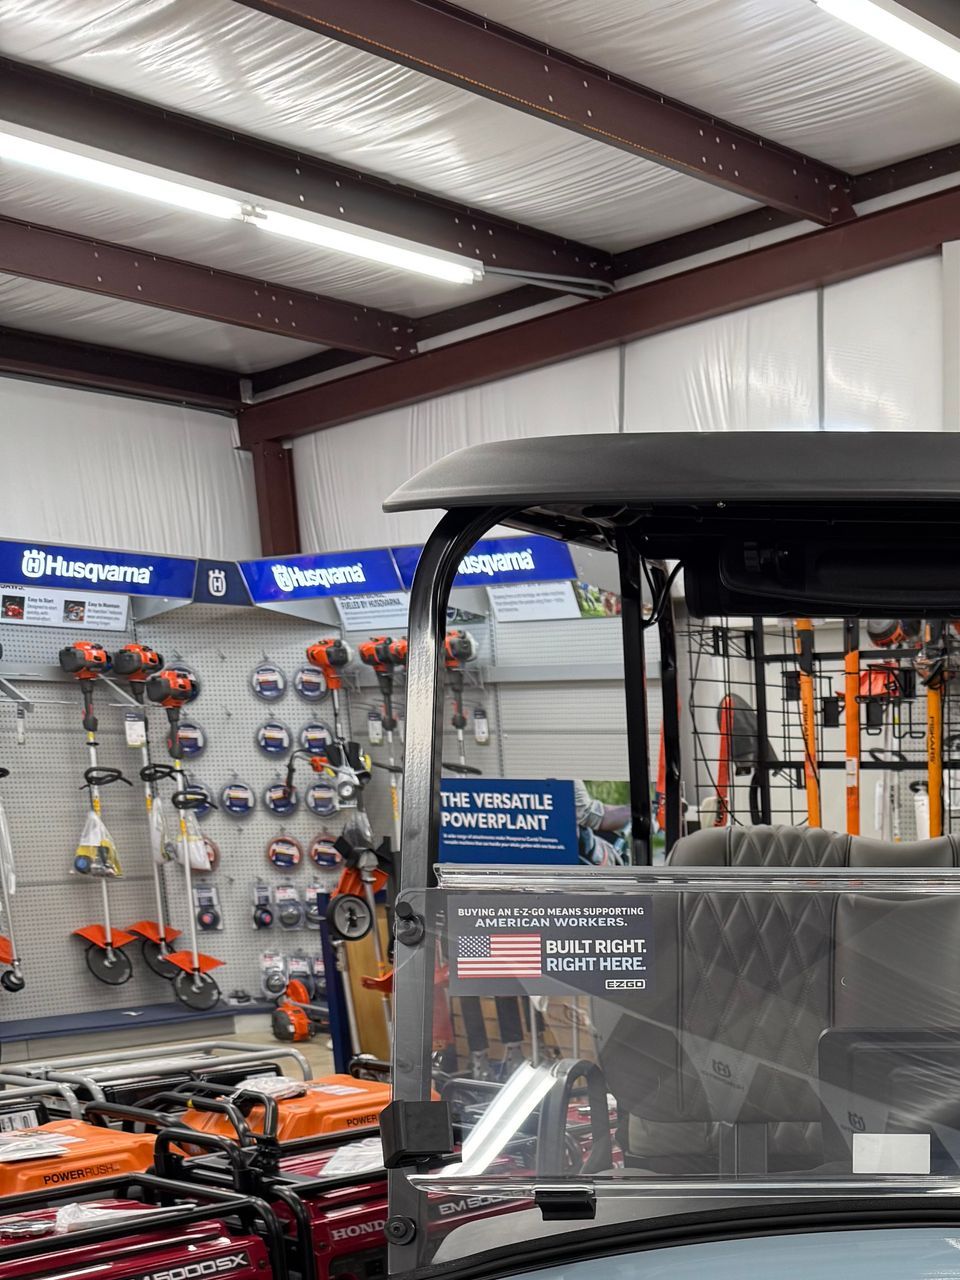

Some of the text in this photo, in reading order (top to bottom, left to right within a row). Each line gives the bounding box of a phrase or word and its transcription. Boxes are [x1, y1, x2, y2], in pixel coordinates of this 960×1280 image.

[45, 554, 150, 584] Husqvarna
[458, 551, 535, 576] usqvarna
[290, 564, 366, 589] Husqvarna
[440, 792, 553, 810] THE VERSATILE
[441, 812, 549, 831] POWERPLANT
[458, 907, 644, 916] BUYING AN E-Z-GO MEANS SUPPORTING
[475, 917, 628, 927] AMERICAN WORKERS.
[546, 939, 646, 954] BUILT RIGHT.
[546, 957, 646, 971] RIGHT HERE.
[43, 1163, 114, 1184] POWERRUSH
[332, 1220, 386, 1240] HOND
